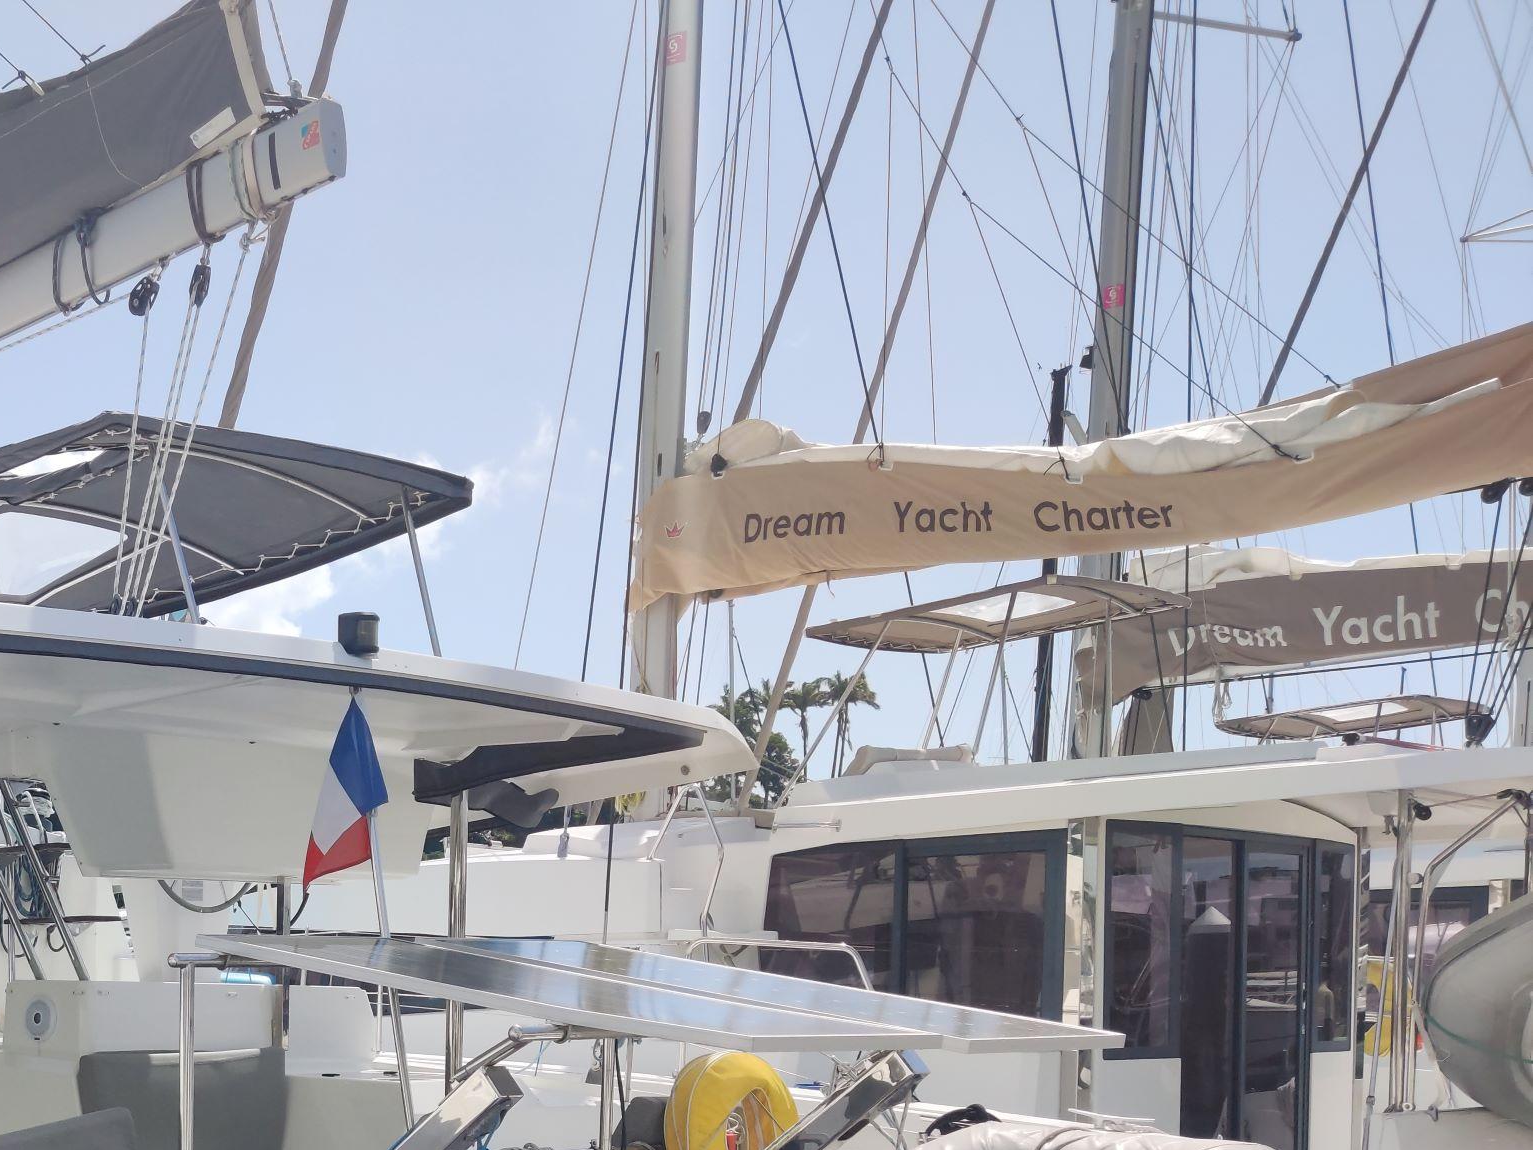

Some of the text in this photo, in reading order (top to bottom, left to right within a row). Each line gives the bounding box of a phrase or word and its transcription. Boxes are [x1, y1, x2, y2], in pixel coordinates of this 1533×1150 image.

[744, 499, 1173, 544] Dream Yacht Charter
[1167, 622, 1289, 657] Dream
[1312, 594, 1441, 647] Yacht
